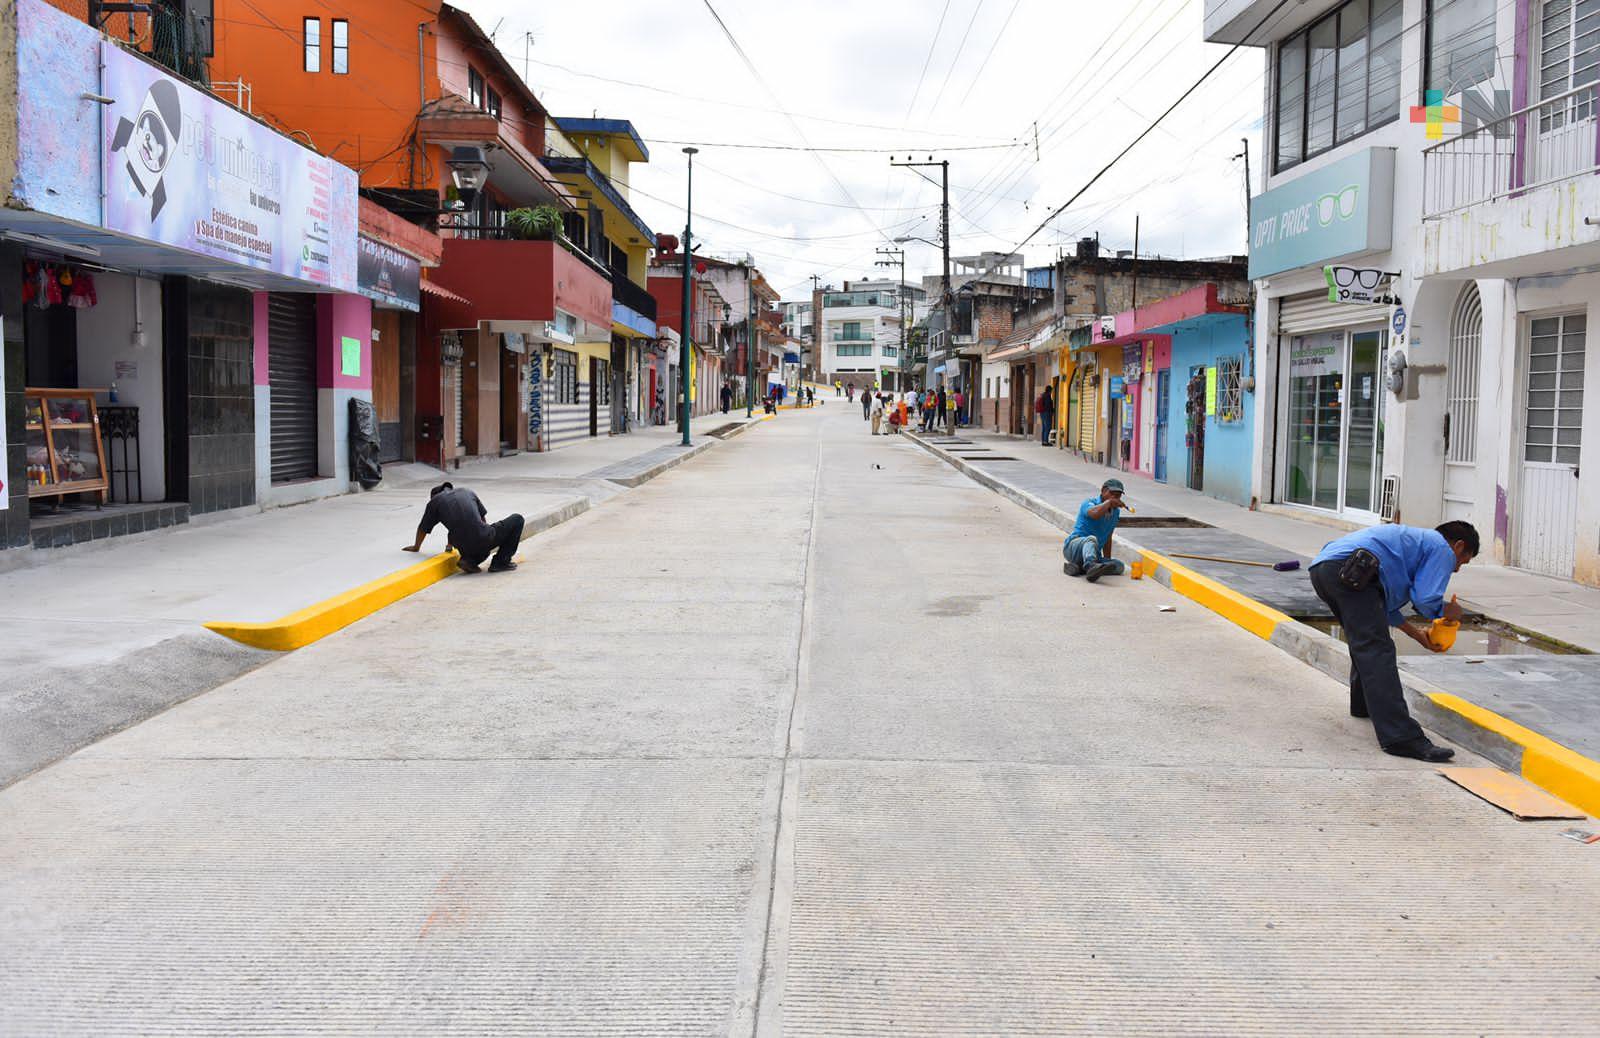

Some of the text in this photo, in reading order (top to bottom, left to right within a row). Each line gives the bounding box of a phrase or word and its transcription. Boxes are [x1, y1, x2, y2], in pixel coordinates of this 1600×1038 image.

[212, 208, 237, 229] Estética
[1255, 202, 1312, 248] OPTI PRICE
[201, 219, 214, 238] Spa
[214, 225, 224, 240] de
[224, 229, 247, 248] manejo
[247, 237, 272, 255] especial
